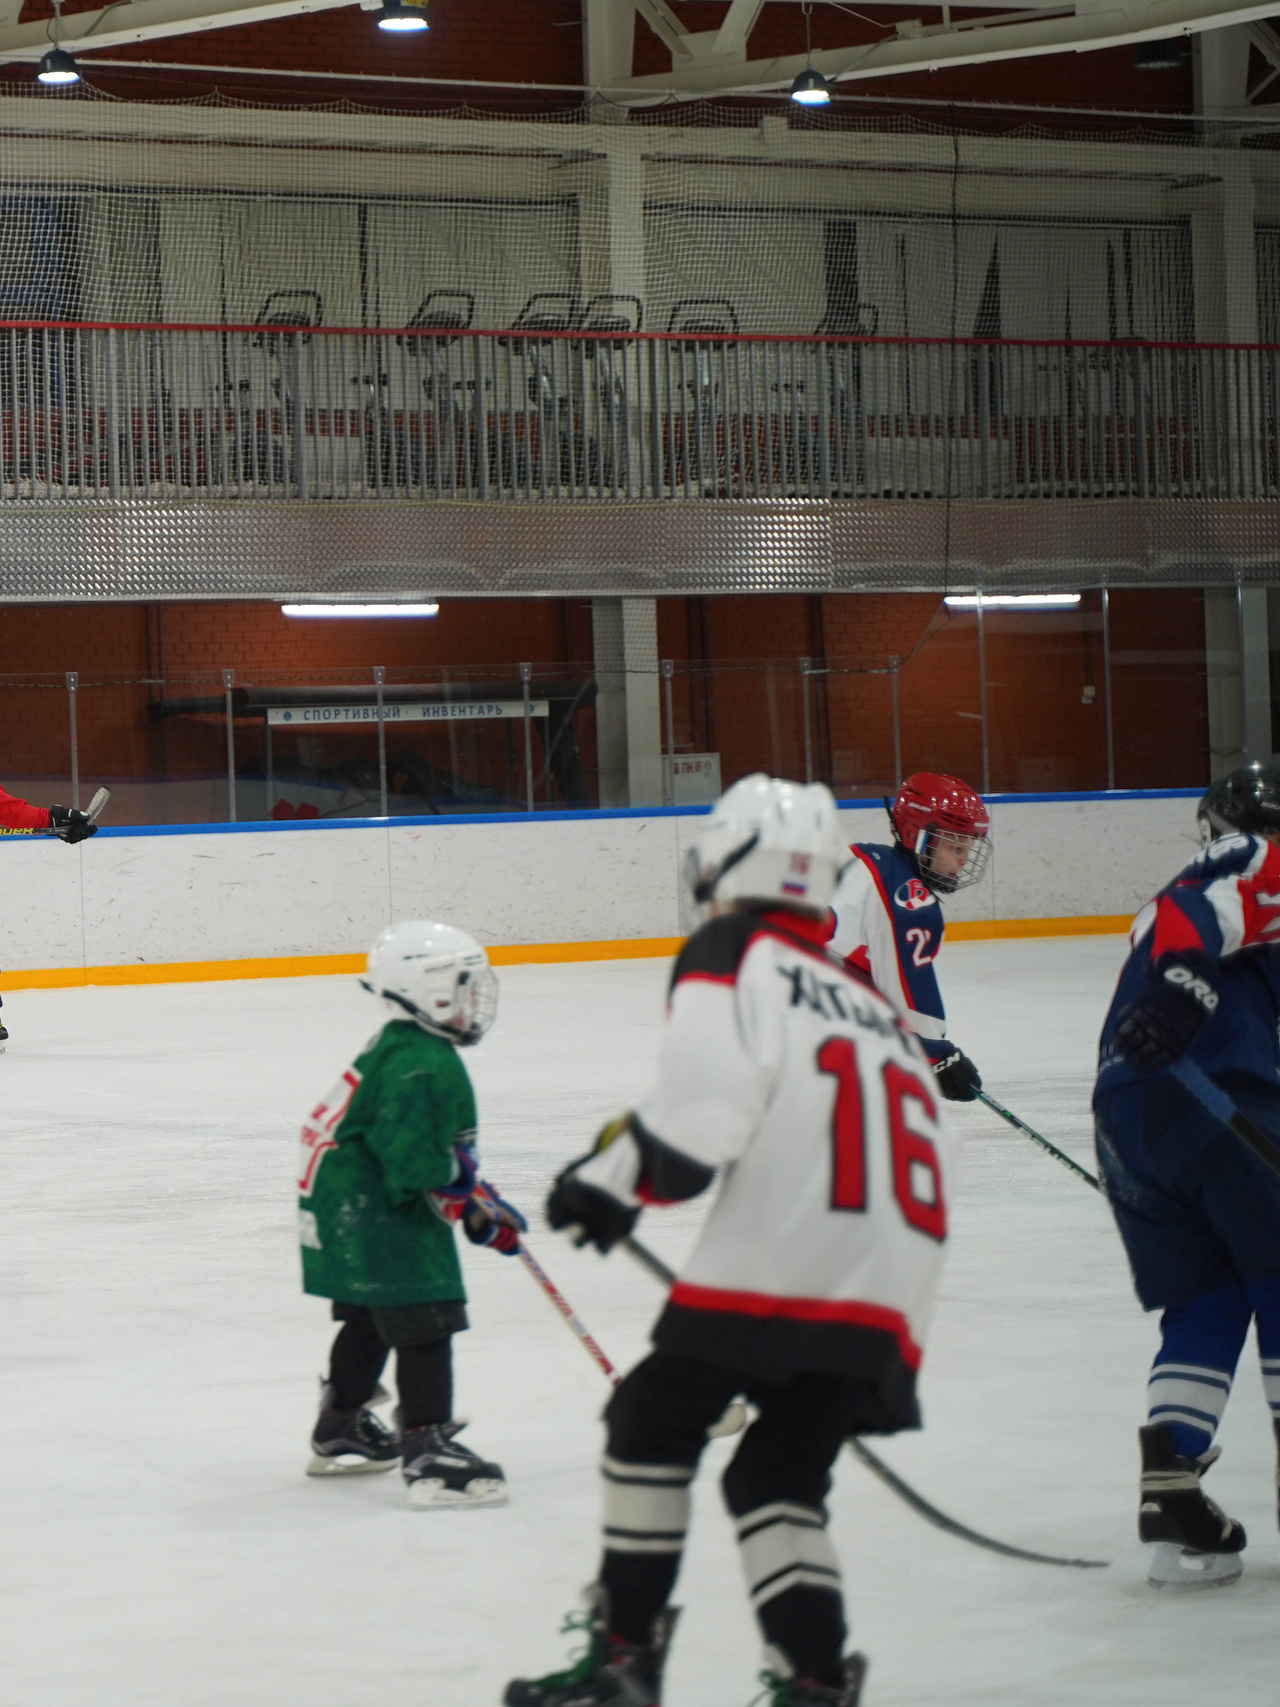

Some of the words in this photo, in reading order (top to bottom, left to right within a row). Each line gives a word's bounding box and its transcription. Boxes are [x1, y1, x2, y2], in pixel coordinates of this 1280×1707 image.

[303, 707, 401, 722] СПОРТИВНЫЙ
[422, 704, 503, 718] ИНВЕНТАРЬ
[929, 1052, 961, 1075] CM
[815, 1033, 949, 1244] 16
